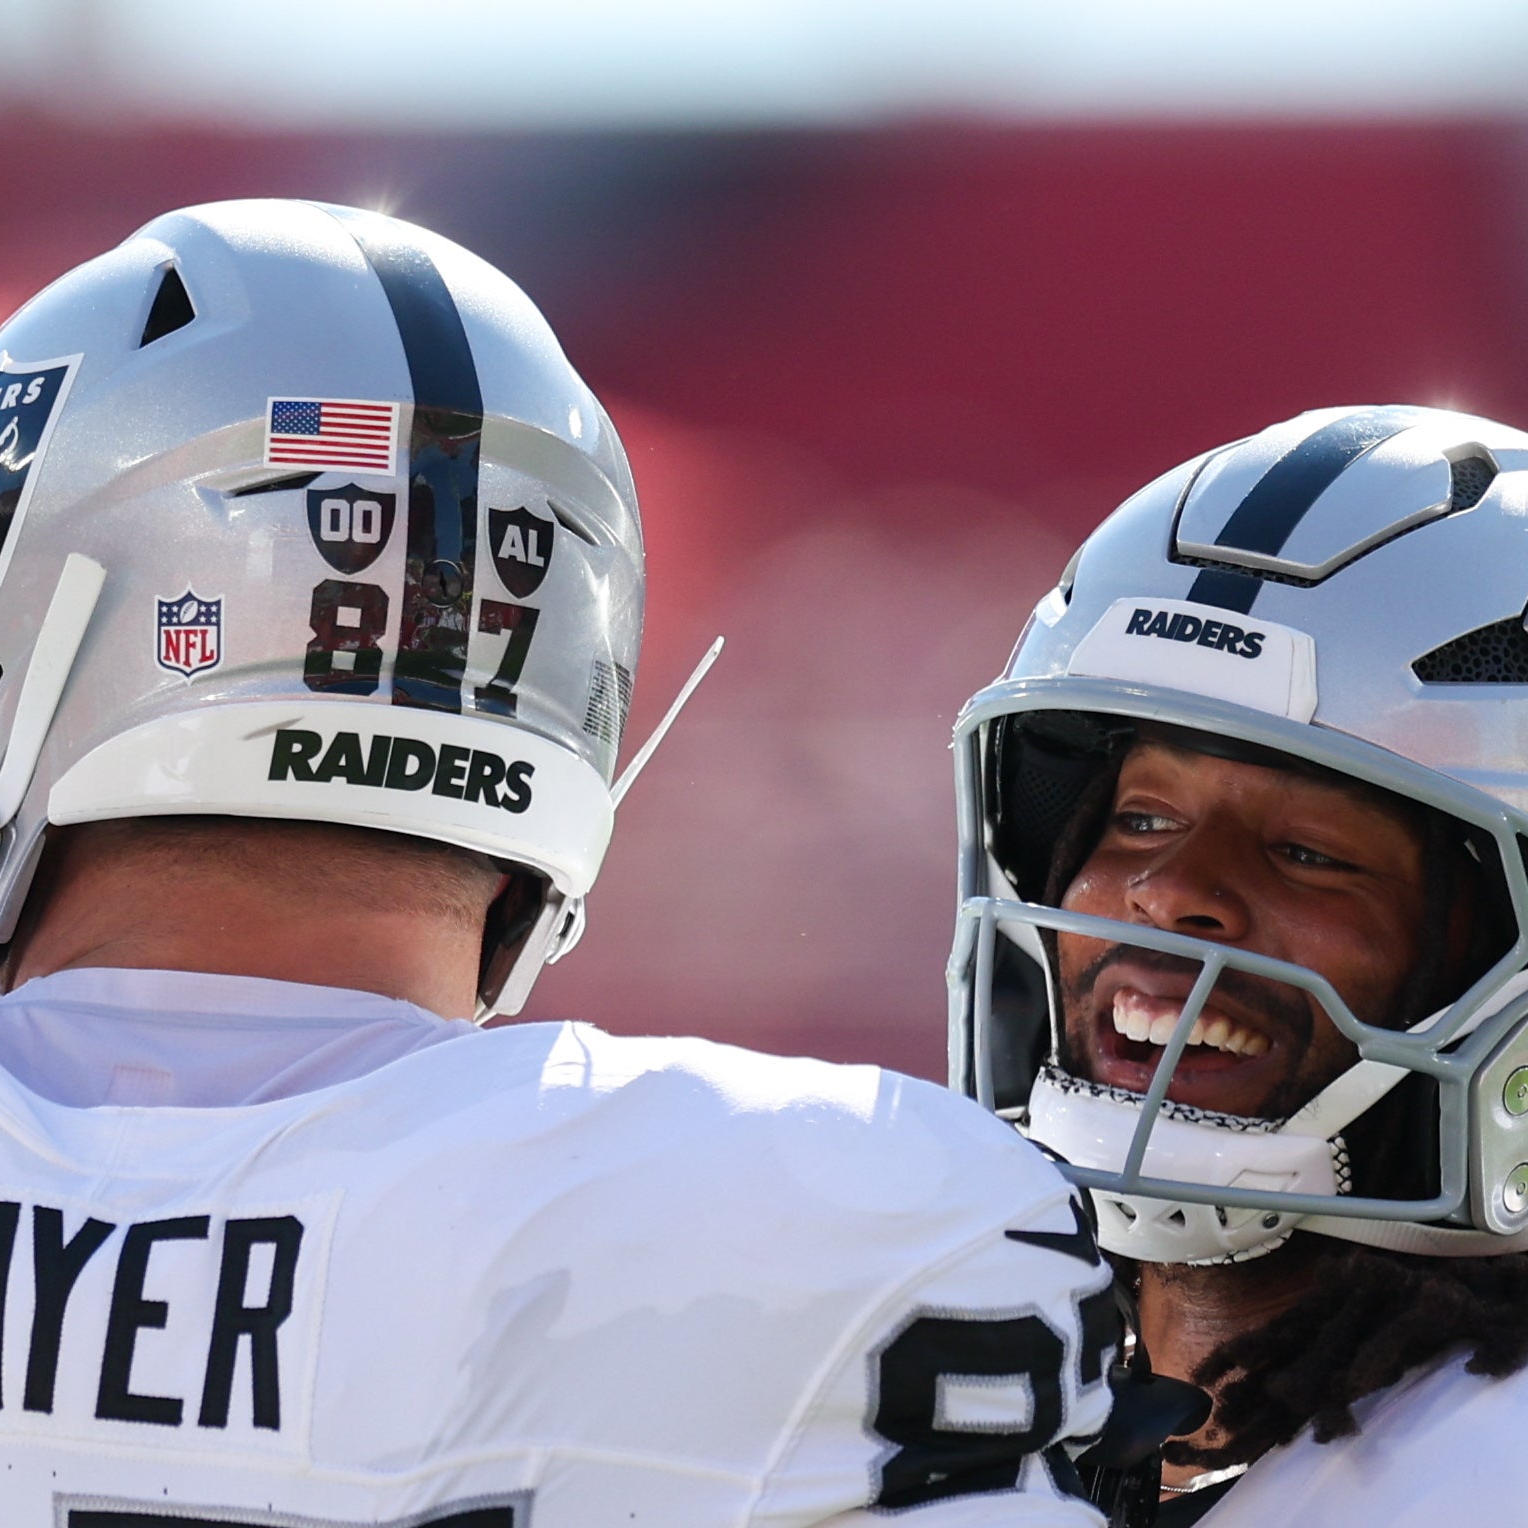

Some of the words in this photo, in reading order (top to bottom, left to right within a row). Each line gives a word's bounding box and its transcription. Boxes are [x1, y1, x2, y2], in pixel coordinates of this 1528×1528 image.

[497, 524, 546, 568] AL
[163, 629, 215, 668] NFL
[1125, 608, 1267, 660] RAIDERS
[268, 729, 536, 815] RAIDERS
